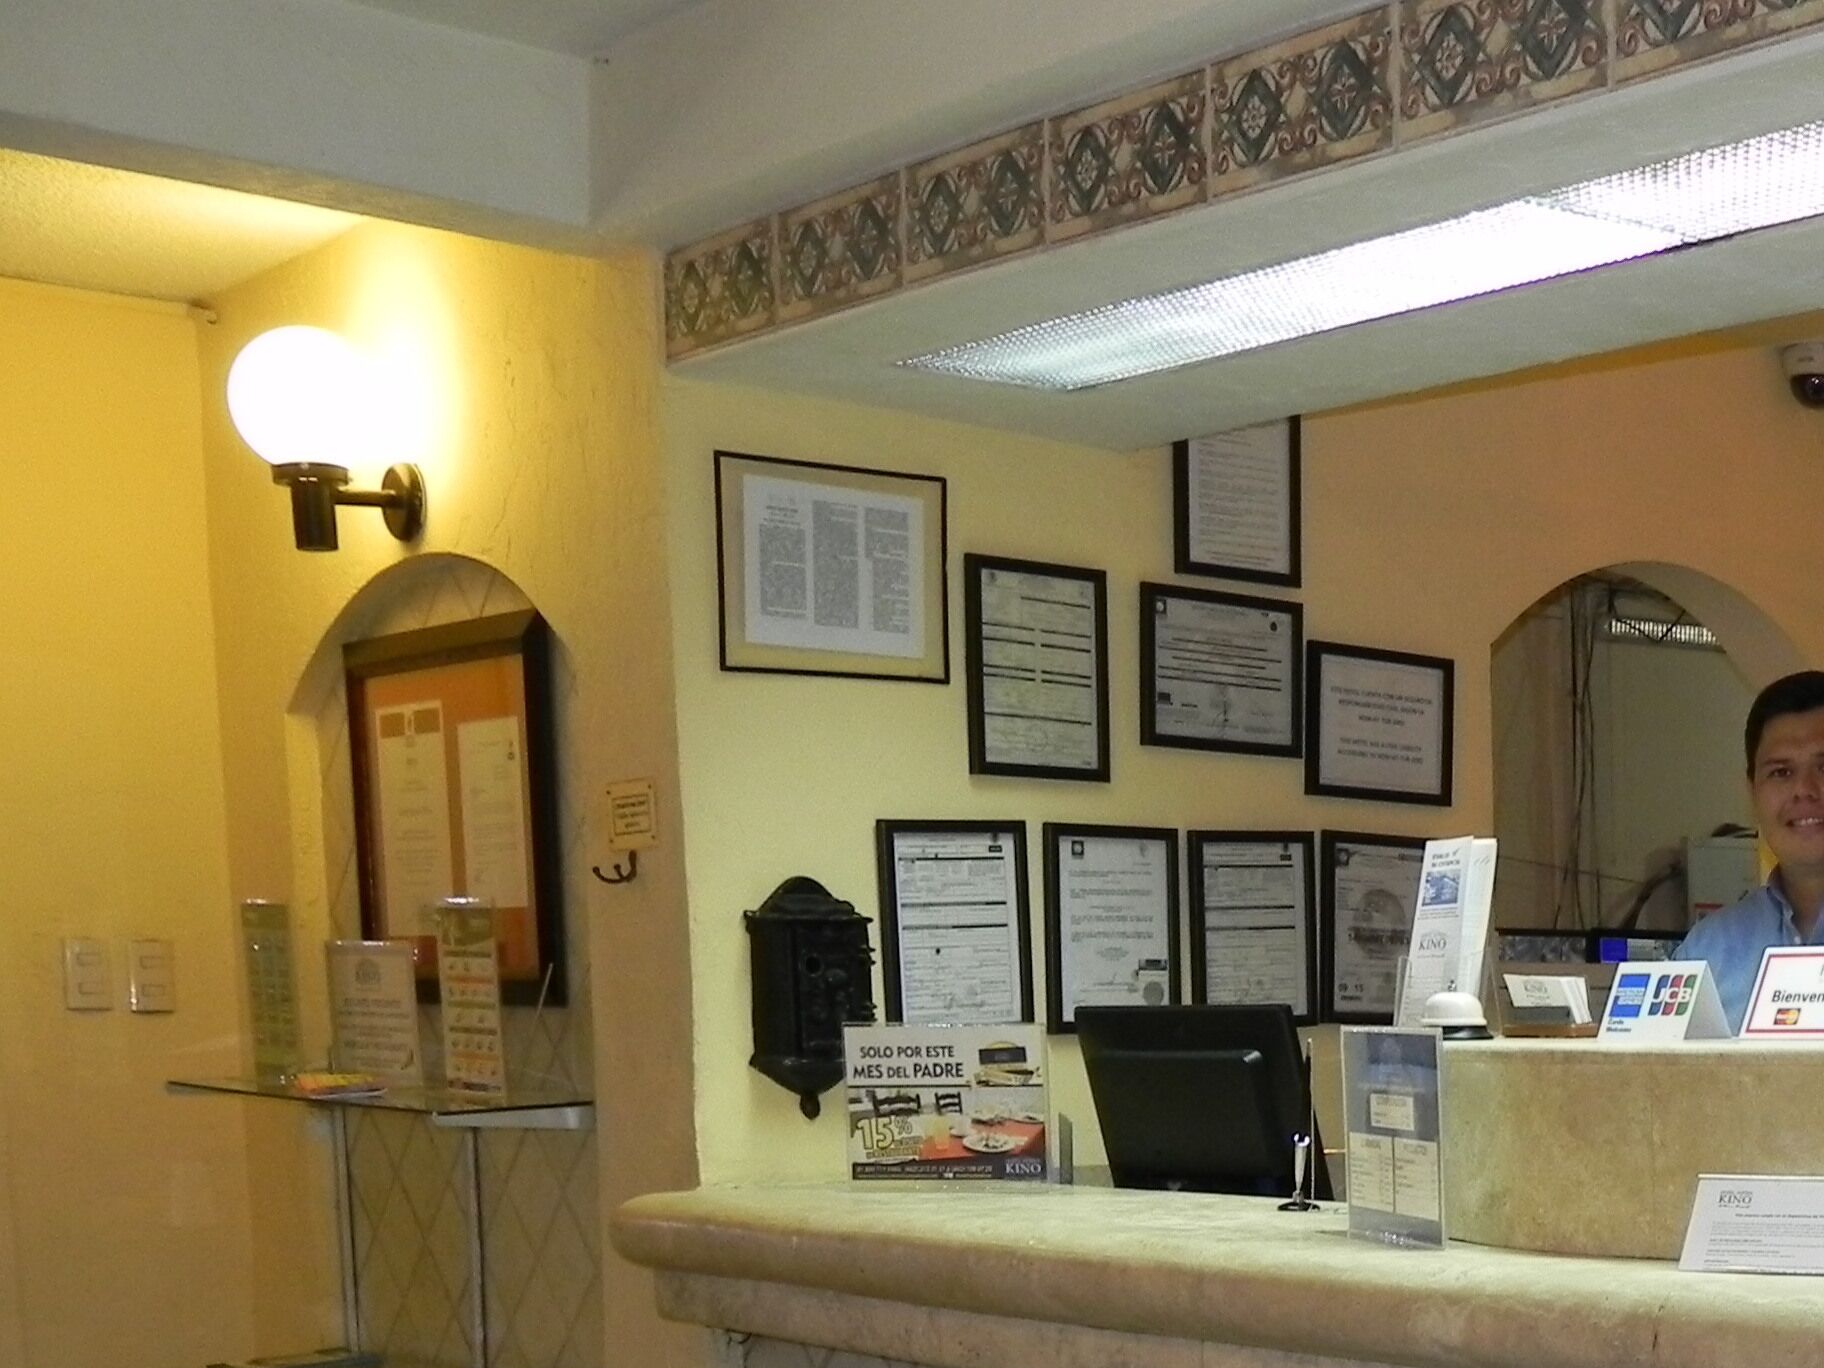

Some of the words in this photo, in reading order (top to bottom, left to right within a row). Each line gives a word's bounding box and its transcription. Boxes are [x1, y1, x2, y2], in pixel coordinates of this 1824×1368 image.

[1418, 937, 1447, 951] KINO
[1651, 987, 1693, 1003] JCB
[859, 1046, 893, 1059] SOLO
[897, 1046, 923, 1059] POR
[925, 1045, 955, 1058] ESTE
[852, 1063, 884, 1079] MES
[886, 1065, 911, 1079] DEL
[912, 1062, 965, 1078] PADRE
[856, 1116, 913, 1151] 15%
[1005, 1162, 1042, 1174] KINO
[1717, 1193, 1753, 1205] KINO
